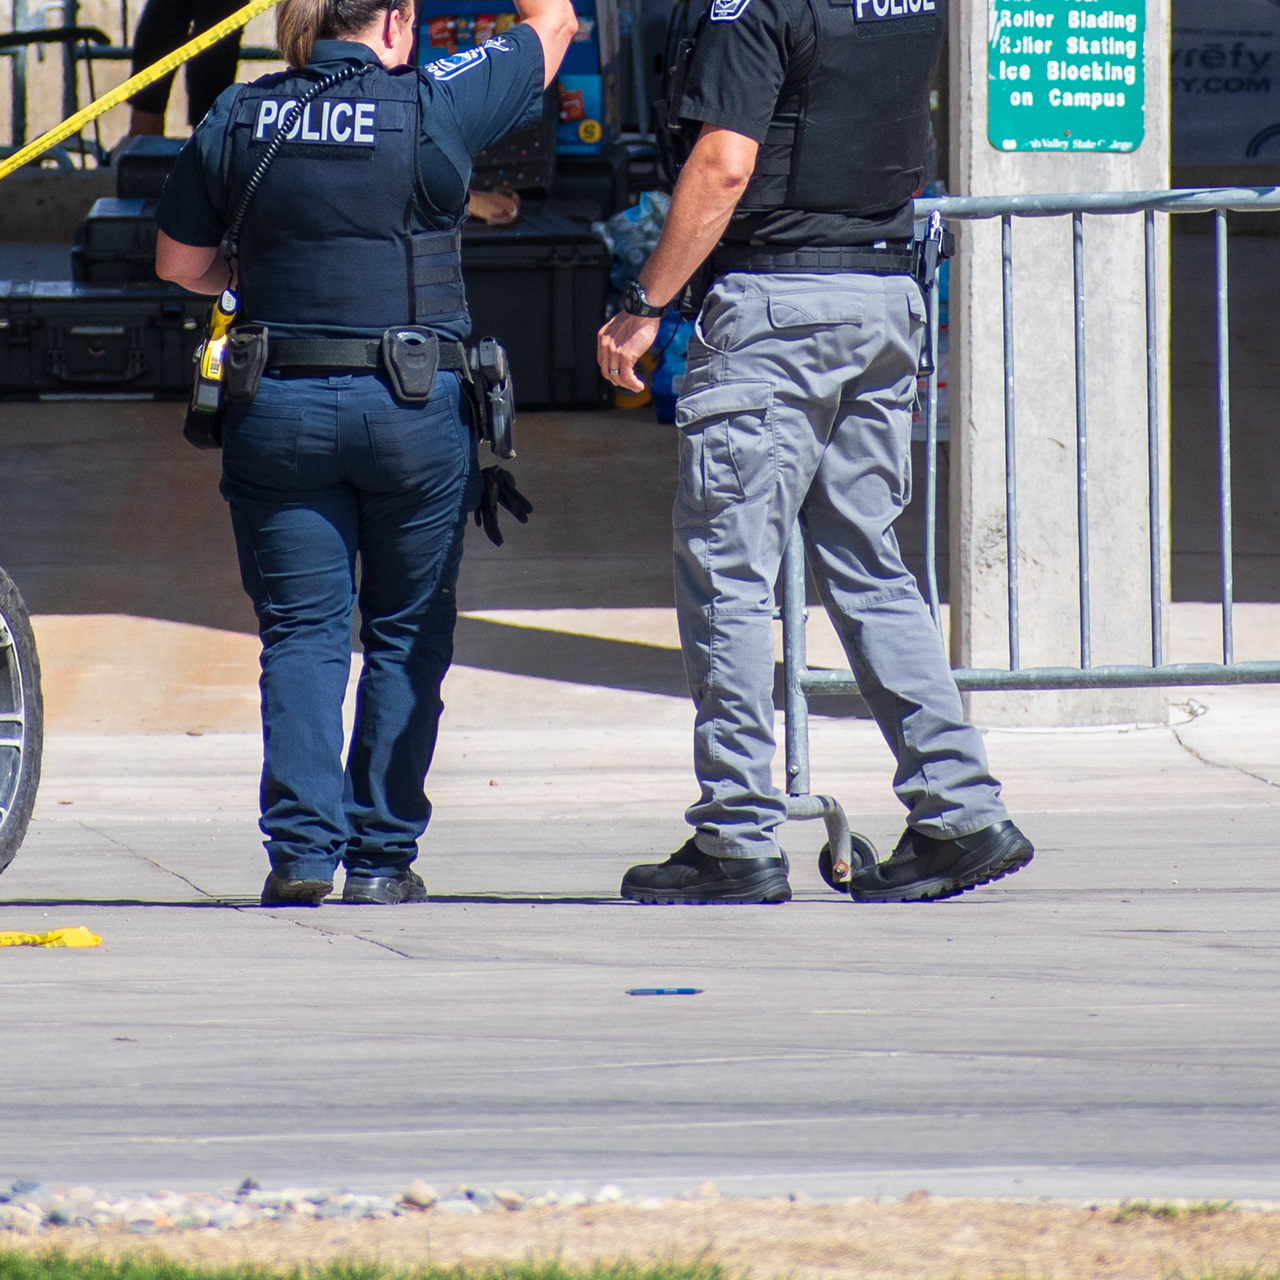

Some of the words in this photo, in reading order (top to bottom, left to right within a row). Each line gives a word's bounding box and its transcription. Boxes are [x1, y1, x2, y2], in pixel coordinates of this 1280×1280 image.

[1000, 10, 1055, 29] Roller
[1068, 10, 1137, 33] Blading
[1066, 36, 1136, 59] Skating
[999, 60, 1031, 80] Ice
[1047, 61, 1136, 85] Blocking
[1010, 91, 1034, 106] on
[1048, 88, 1126, 111] Campus
[256, 99, 376, 143] POLICE
